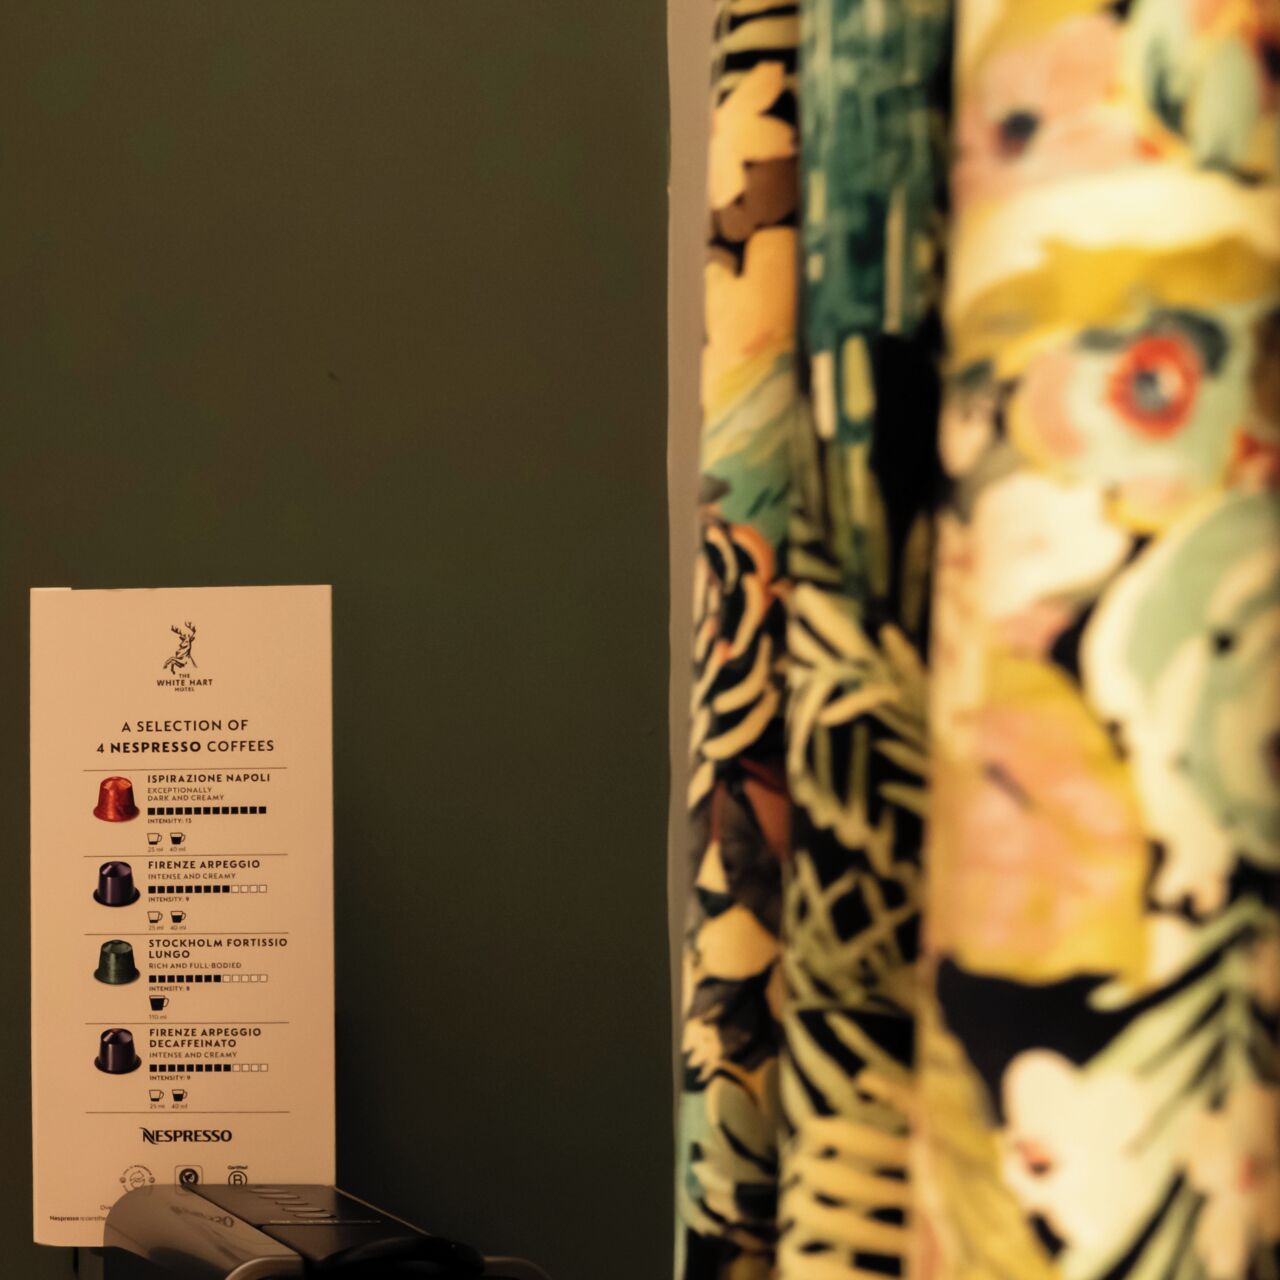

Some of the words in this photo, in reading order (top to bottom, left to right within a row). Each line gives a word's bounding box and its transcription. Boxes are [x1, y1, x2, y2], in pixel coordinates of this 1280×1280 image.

[156, 679, 185, 687] WHITE
[189, 678, 213, 686] HART
[121, 721, 131, 732] A
[137, 719, 222, 732] SELECTION
[228, 719, 249, 731] OF
[96, 743, 105, 754] 4
[110, 741, 201, 754] NESPRESSO
[207, 740, 274, 752] COFFEES
[147, 774, 222, 783] ISPIRAZIONE
[226, 773, 270, 782] NAPOLI
[148, 861, 196, 869] FIRENZE
[200, 860, 260, 869] ARPEGGIO
[149, 939, 223, 948] STOCKHOLM
[227, 938, 288, 947] FORTISSIO
[149, 950, 190, 959] LUNGO
[149, 1028, 197, 1037] FIRENZE
[201, 1028, 261, 1037] ARPEGGIO
[149, 1039, 237, 1048] DECAFFEINATO
[139, 1127, 232, 1145] NESPRESSO
